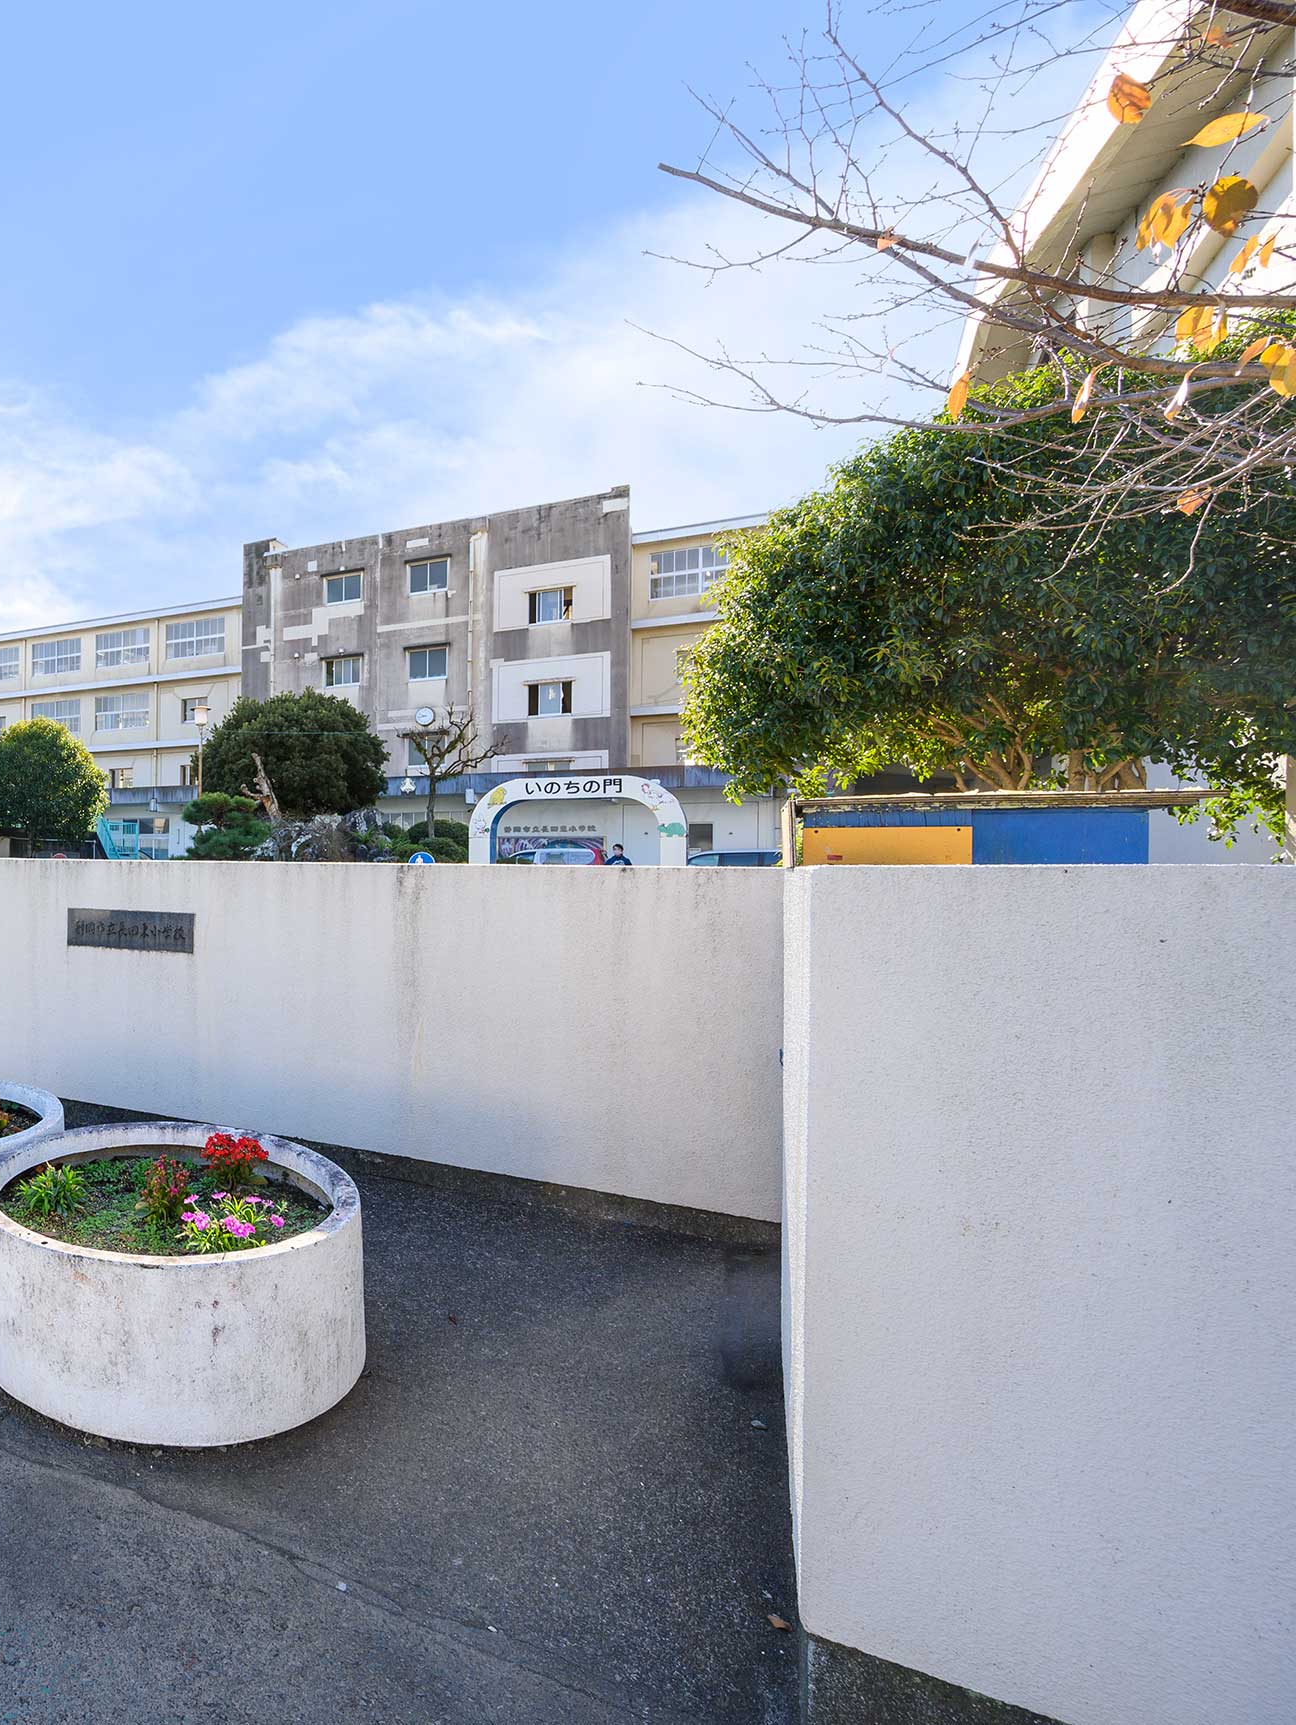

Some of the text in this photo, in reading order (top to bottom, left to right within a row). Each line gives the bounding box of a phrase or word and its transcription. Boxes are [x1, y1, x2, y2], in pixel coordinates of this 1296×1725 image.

[525, 778, 623, 795] いのちの門
